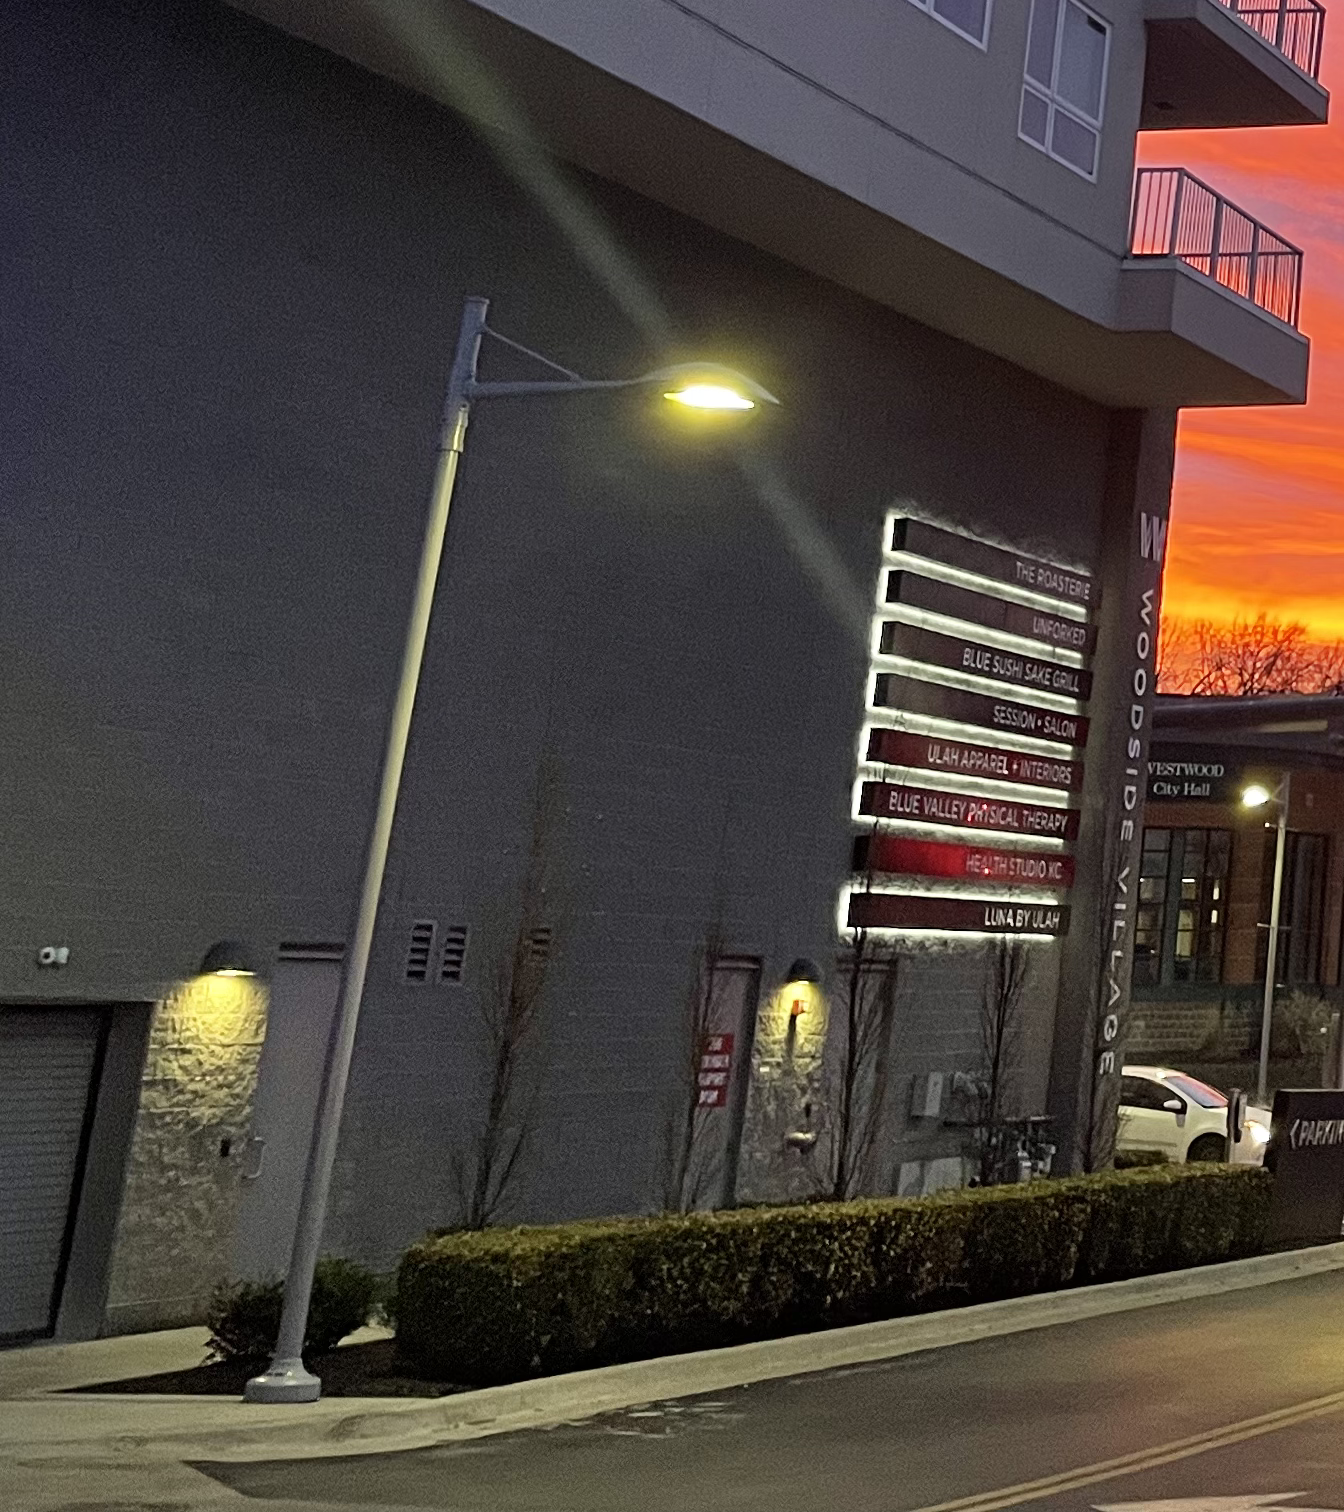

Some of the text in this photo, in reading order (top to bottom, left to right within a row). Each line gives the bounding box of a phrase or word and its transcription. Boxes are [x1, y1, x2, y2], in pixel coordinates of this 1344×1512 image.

[1015, 561, 1091, 601] THE ROASTERIE
[1033, 617, 1086, 645] UNFORKED
[962, 647, 1080, 693] BLUE SUSHI SAKE GRILL
[993, 705, 1078, 739] SESSION SALON
[927, 743, 959, 766] ULAH
[960, 749, 1009, 775] APPAREL
[1020, 760, 1072, 785] INTERIORS
[1152, 781, 1211, 797] City Hall
[889, 791, 1069, 834] BLUE VALLEY PHYSICAL THERAPY
[1099, 588, 1154, 1076] WOODSIDE VILLAGE
[966, 854, 1063, 879] HEALTH STUDIO KC
[984, 906, 1061, 930] LUNA BY ULAH
